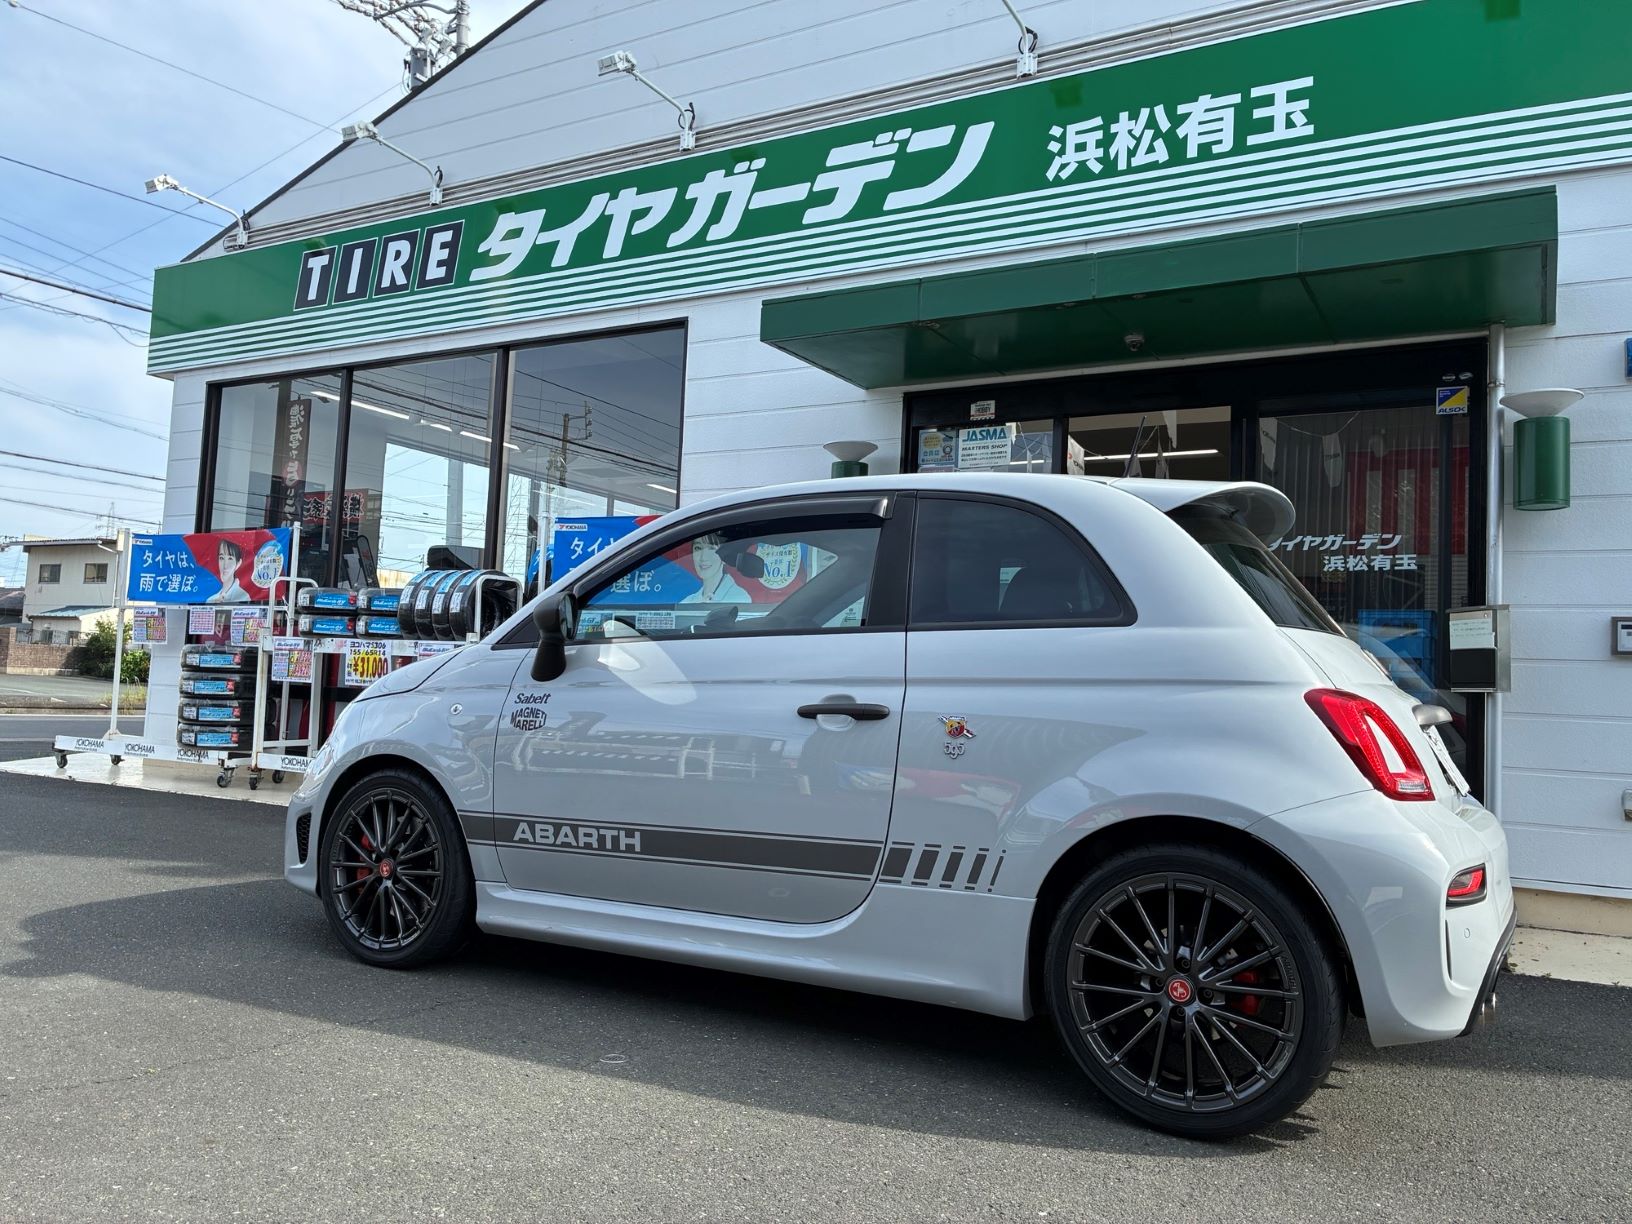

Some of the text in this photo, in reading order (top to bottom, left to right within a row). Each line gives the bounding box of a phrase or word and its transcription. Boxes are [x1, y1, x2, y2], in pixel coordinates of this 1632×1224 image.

[1046, 76, 1314, 182] 浜松有玉
[469, 121, 996, 282] タイヤガーデン
[306, 229, 453, 302] TIRE
[961, 428, 1007, 442] JASMA
[143, 549, 195, 569] タイヤは、
[1322, 553, 1418, 572] 浜松有玉
[139, 573, 198, 592] 雨で選ぼ。
[349, 649, 386, 657] 155/65R14
[514, 692, 552, 705] Sabelt
[76, 739, 105, 748] YOKOHAMA
[125, 743, 155, 754] YOKOHAMA
[280, 756, 312, 767] YOKOHAM
[513, 821, 642, 853] ABARTH
